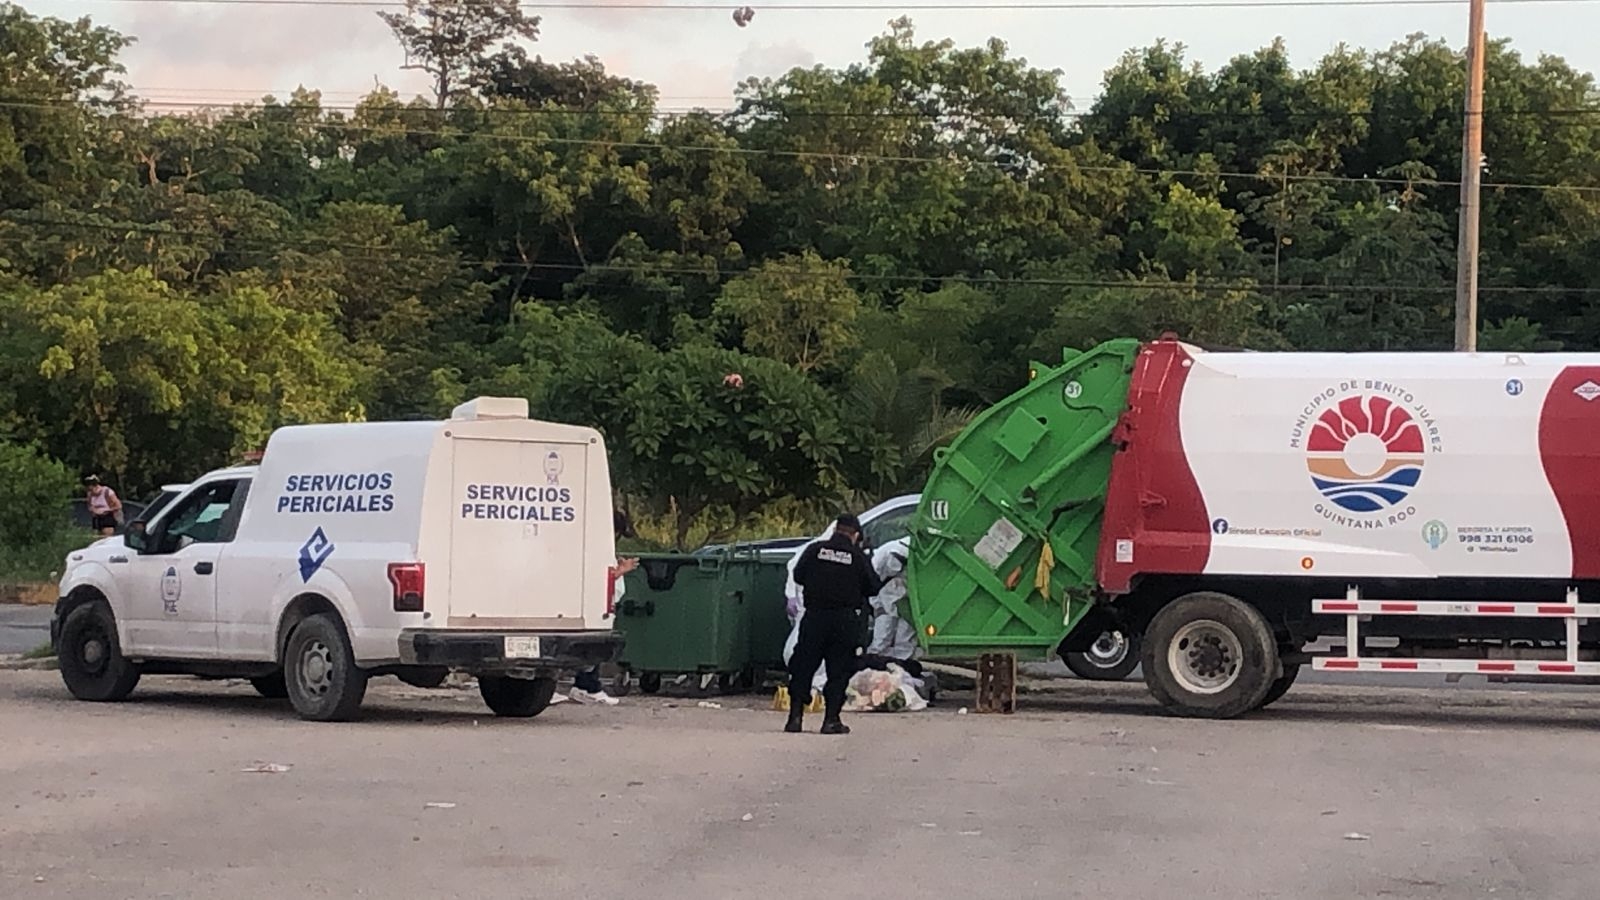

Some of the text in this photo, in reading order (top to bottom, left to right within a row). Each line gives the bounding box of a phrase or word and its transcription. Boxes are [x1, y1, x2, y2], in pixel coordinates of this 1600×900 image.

[1290, 380, 1443, 453] MUNICIPIO DE BENITO JUÁREZ
[286, 473, 393, 491] SERVICIOS
[467, 484, 571, 503] SERVICIOS
[277, 494, 394, 513] PERICIALES
[462, 503, 575, 522] PERICIALES
[1314, 503, 1416, 529] QUINTANA ROO
[1459, 534, 1535, 544] 998 321 6106
